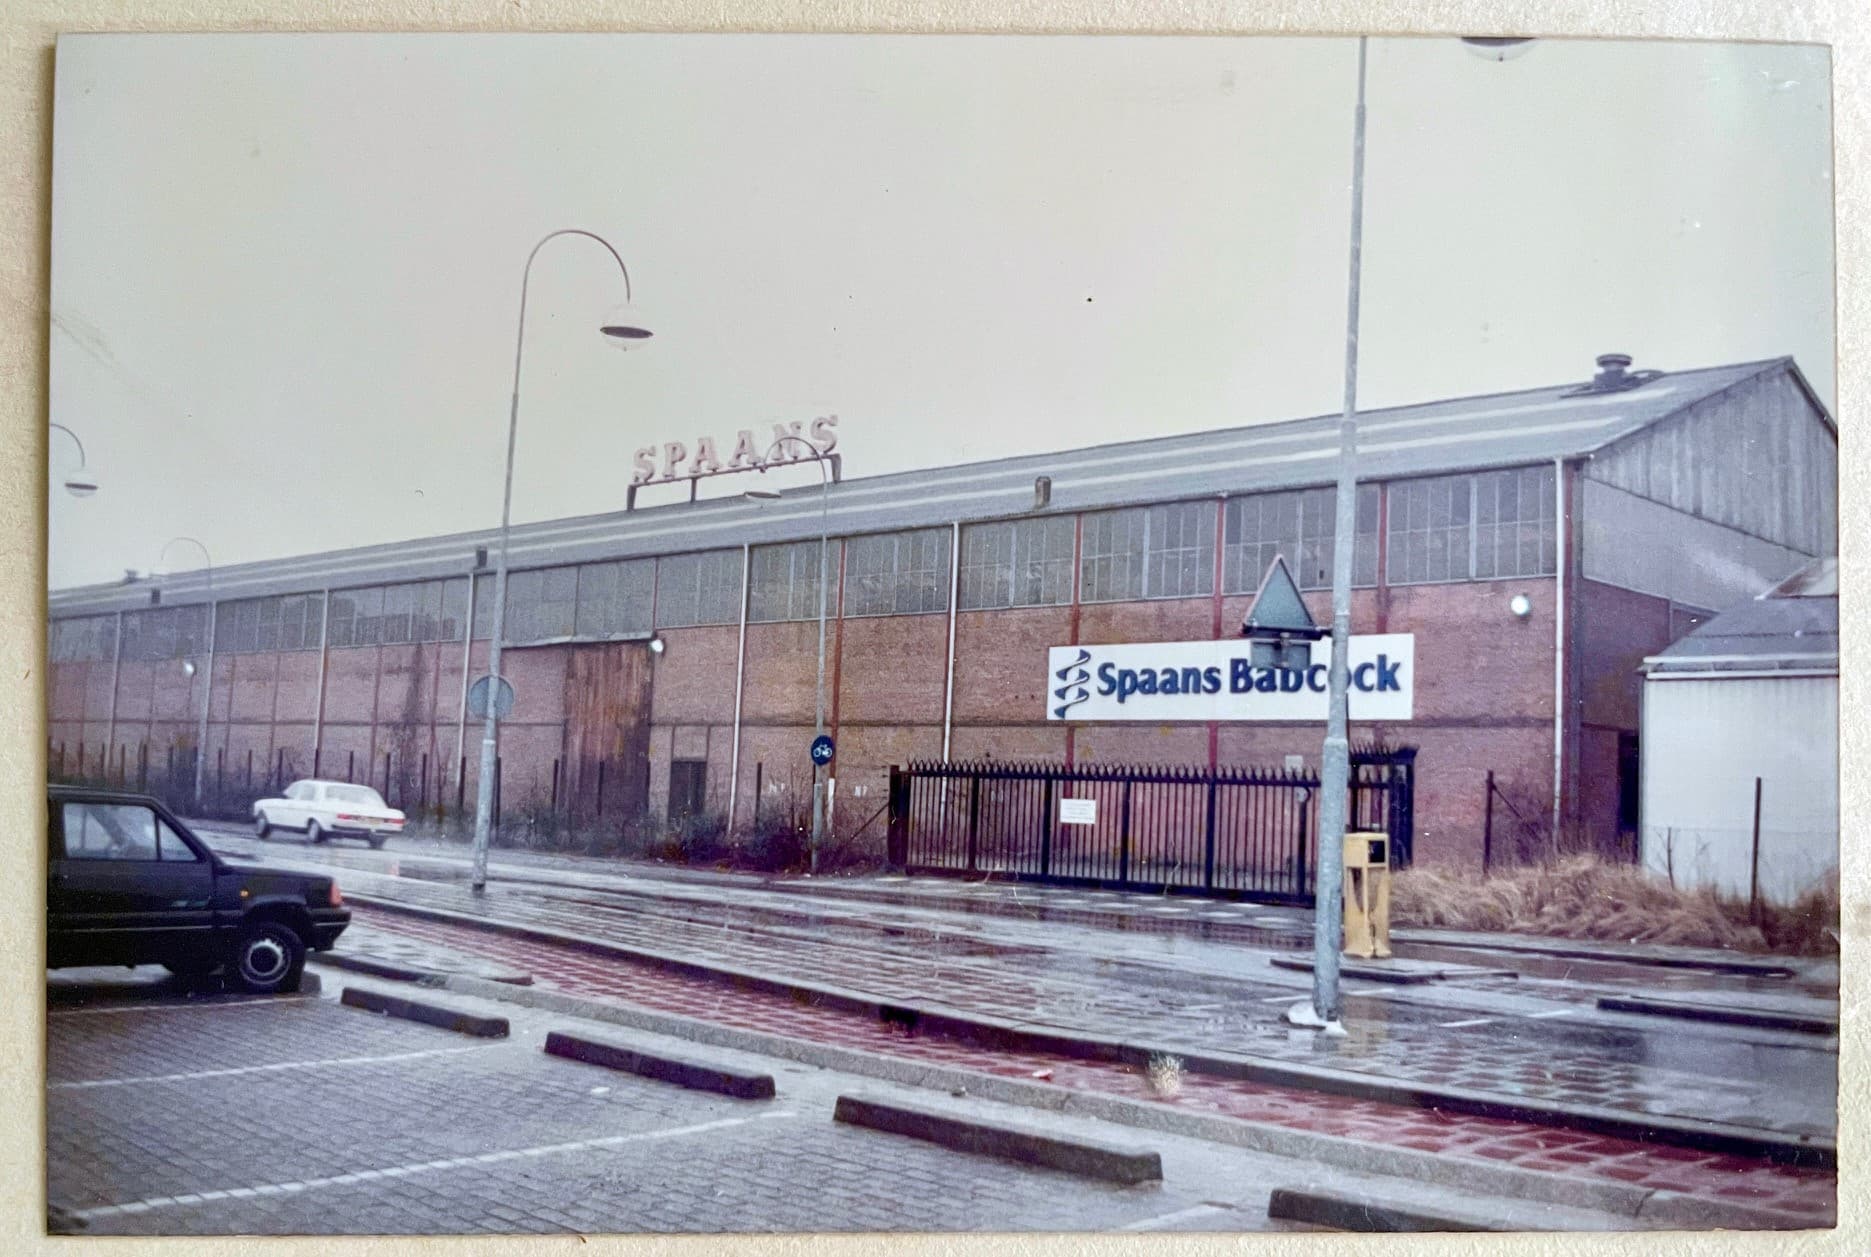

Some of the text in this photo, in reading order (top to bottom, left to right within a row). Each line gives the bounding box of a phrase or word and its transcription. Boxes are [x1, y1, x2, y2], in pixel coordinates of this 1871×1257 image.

[633, 414, 838, 482] SPAANS
[1097, 654, 1401, 704] Spaans Babcck
